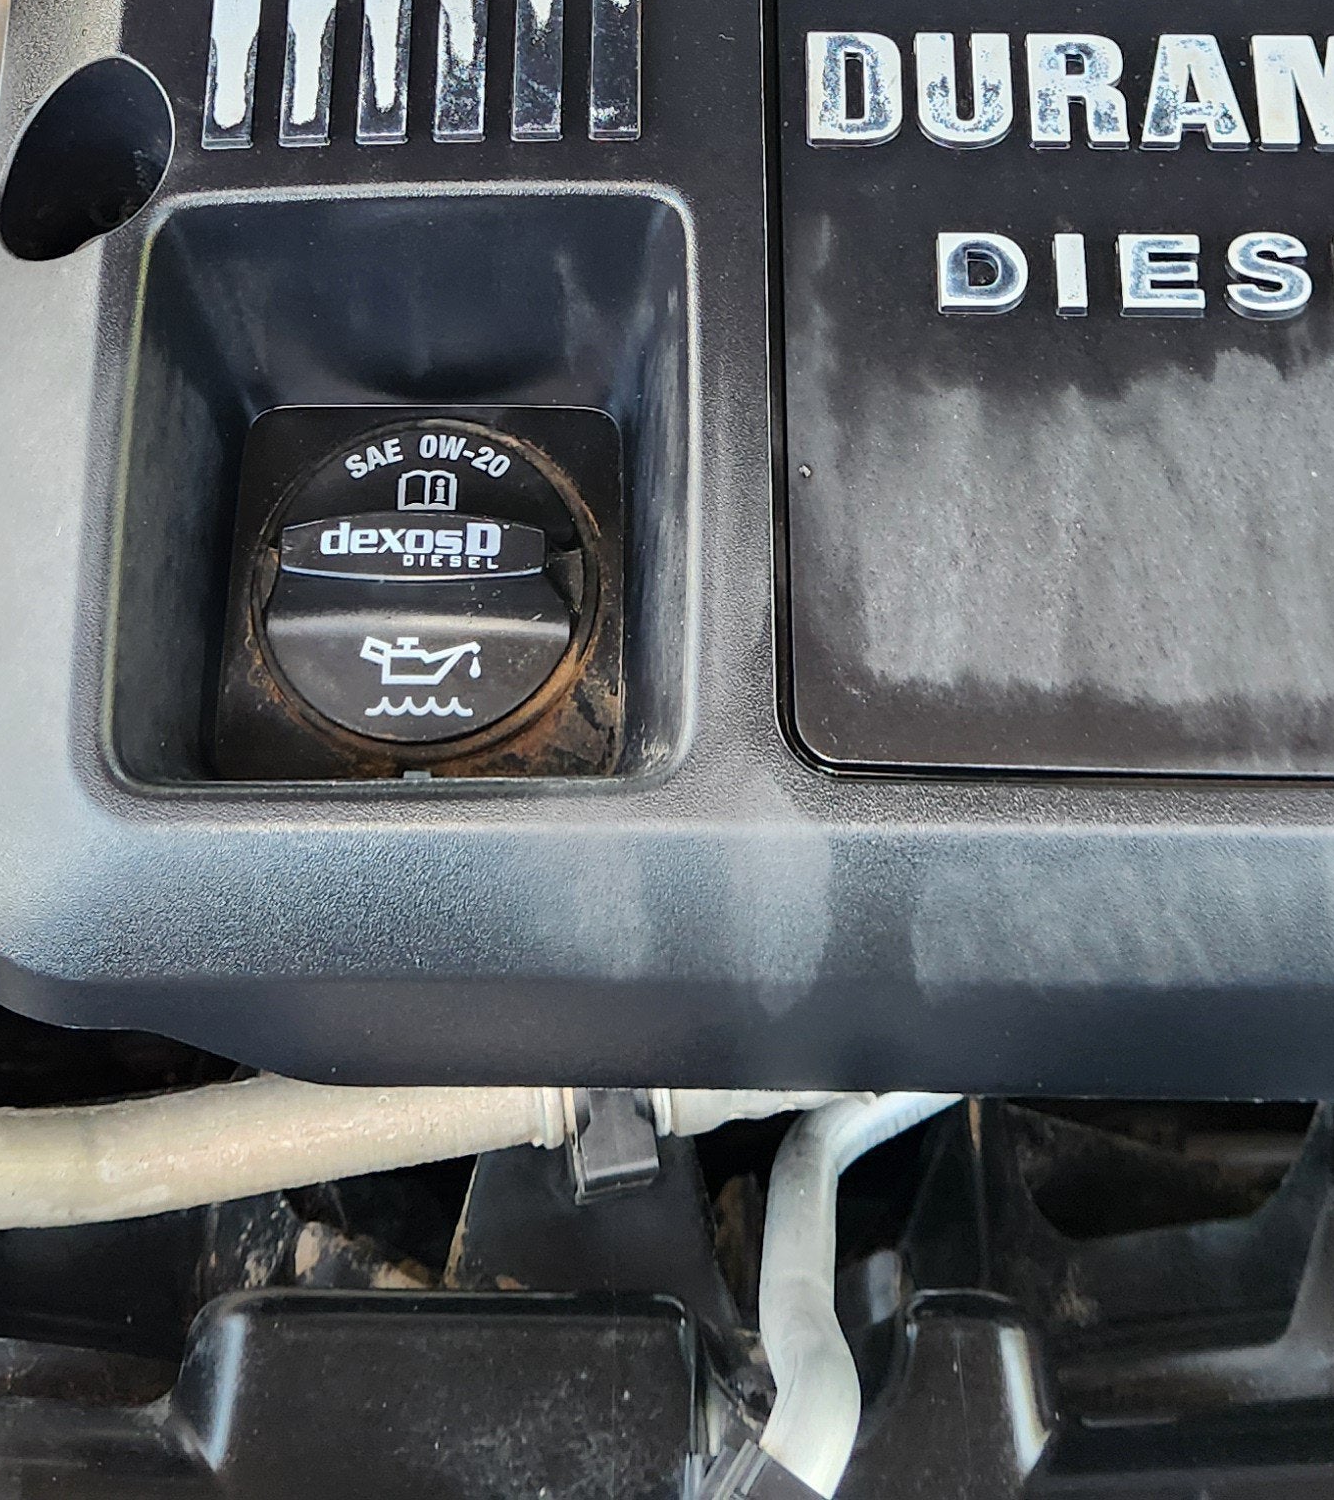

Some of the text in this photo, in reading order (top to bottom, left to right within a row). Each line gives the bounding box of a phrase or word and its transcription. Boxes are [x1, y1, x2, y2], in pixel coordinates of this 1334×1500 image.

[344, 433, 512, 480] SAE 0W-20
[402, 555, 499, 570] DIESEL
